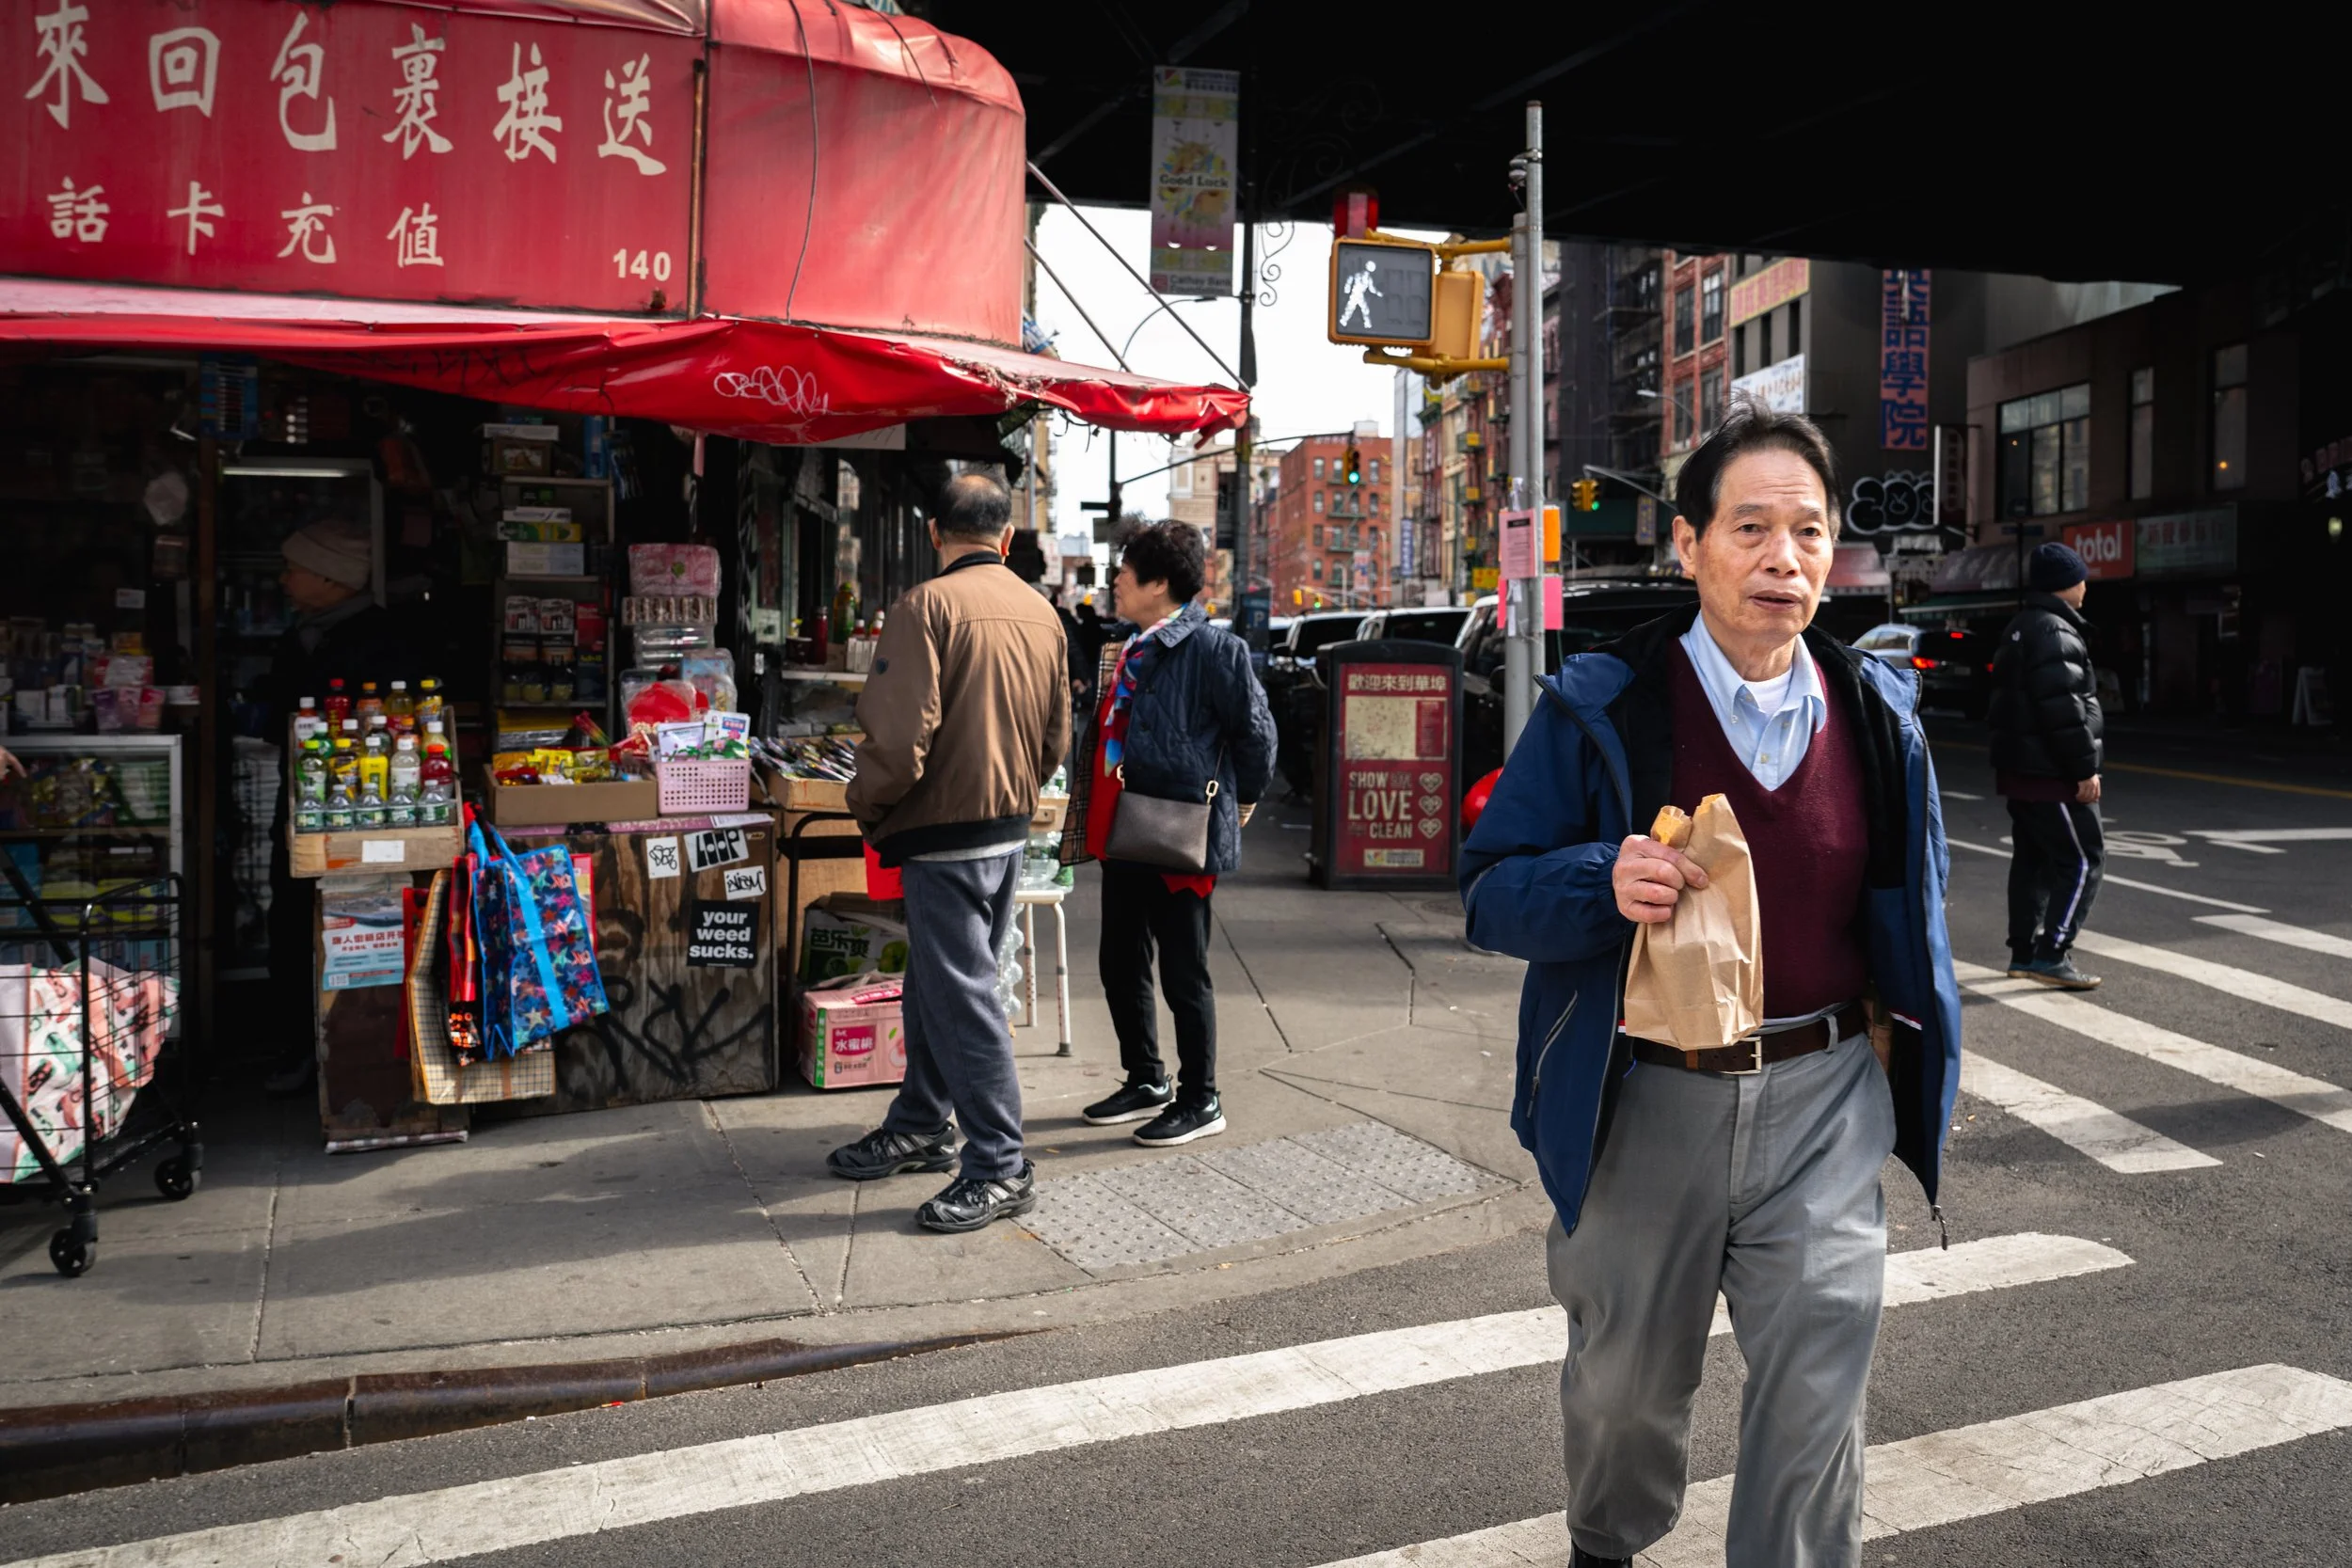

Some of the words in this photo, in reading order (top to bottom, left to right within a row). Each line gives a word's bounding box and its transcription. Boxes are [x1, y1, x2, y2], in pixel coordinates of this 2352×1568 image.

[24, 0, 667, 177] 來回包裹接送
[1159, 173, 1193, 186] Good
[1197, 175, 1229, 189] Luck
[46, 176, 445, 269] 話卡充值
[612, 247, 672, 282] 140
[2075, 523, 2122, 562] total
[1348, 771, 1390, 789] SHOW
[1347, 790, 1414, 821] LOVE
[1369, 822, 1413, 839] CLEAN
[702, 911, 748, 927] your
[696, 927, 751, 942] weed
[689, 943, 755, 959] sucks.
[834, 1036, 874, 1052] 水蜜桃
